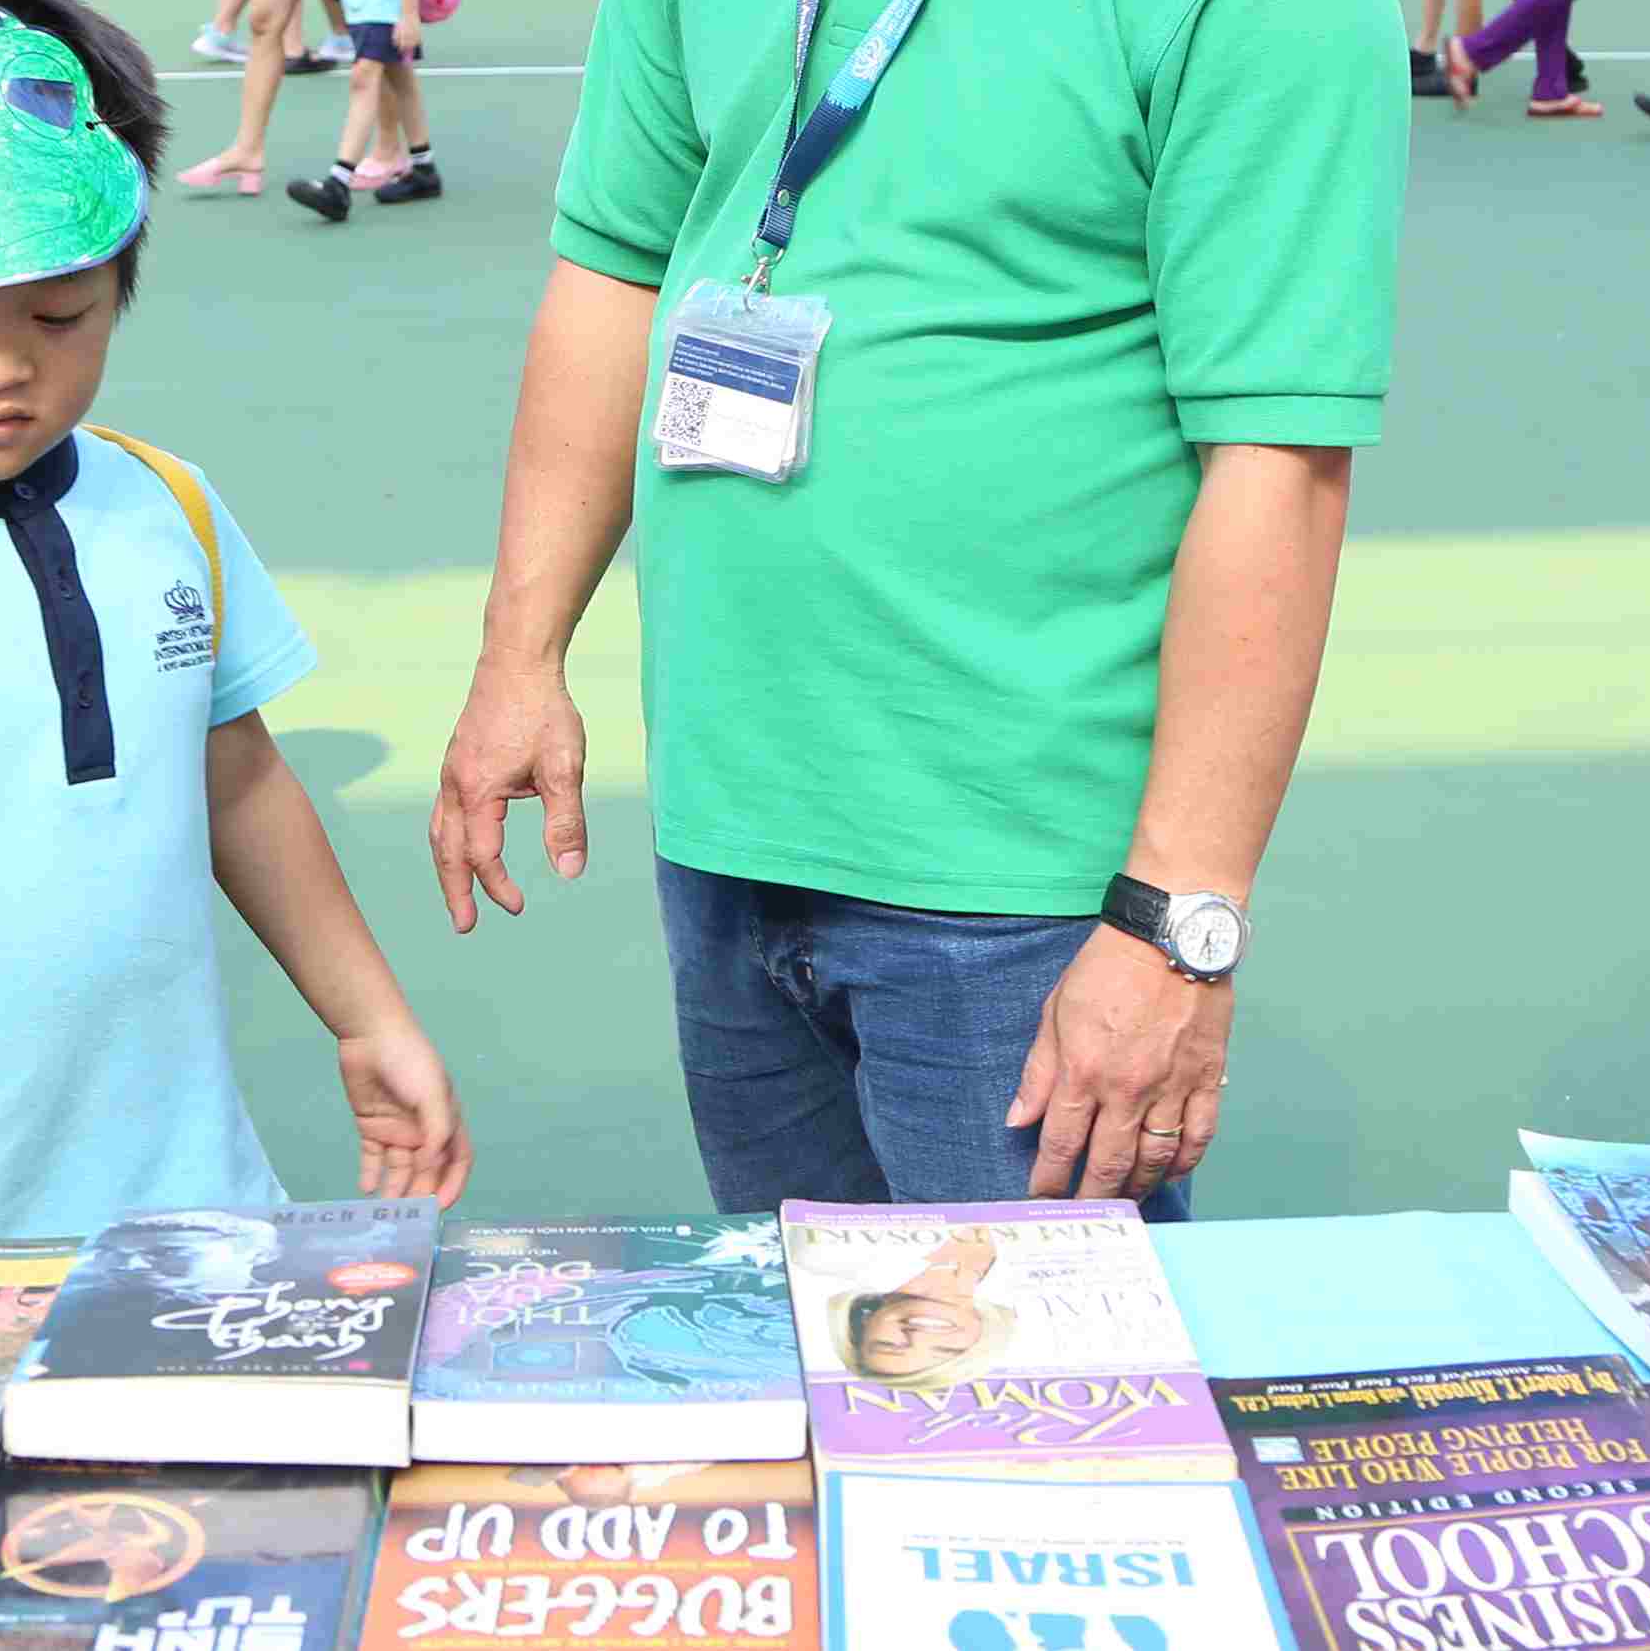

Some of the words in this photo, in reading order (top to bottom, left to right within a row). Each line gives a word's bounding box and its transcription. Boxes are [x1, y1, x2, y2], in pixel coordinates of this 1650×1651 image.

[1039, 1223, 1127, 1241] KIM
[843, 1377, 1189, 1414] WOMAN
[1525, 1370, 1584, 1400] Robert
[1584, 1366, 1621, 1397] By
[1310, 1430, 1438, 1464] PEOPLE
[1440, 1417, 1593, 1458] HELPING
[1578, 1436, 1650, 1468] FOR
[1275, 1463, 1360, 1492] LIKE
[1364, 1455, 1446, 1485] WHO
[1446, 1442, 1574, 1480] PEOPLE
[1314, 1492, 1471, 1521] EDITION
[1493, 1478, 1638, 1506] SECOND
[405, 1502, 515, 1562] UP
[539, 1502, 678, 1561] ADD
[700, 1502, 797, 1561] TO
[901, 1546, 1196, 1589] ISRAEL
[397, 1570, 793, 1638] BUGGERS
